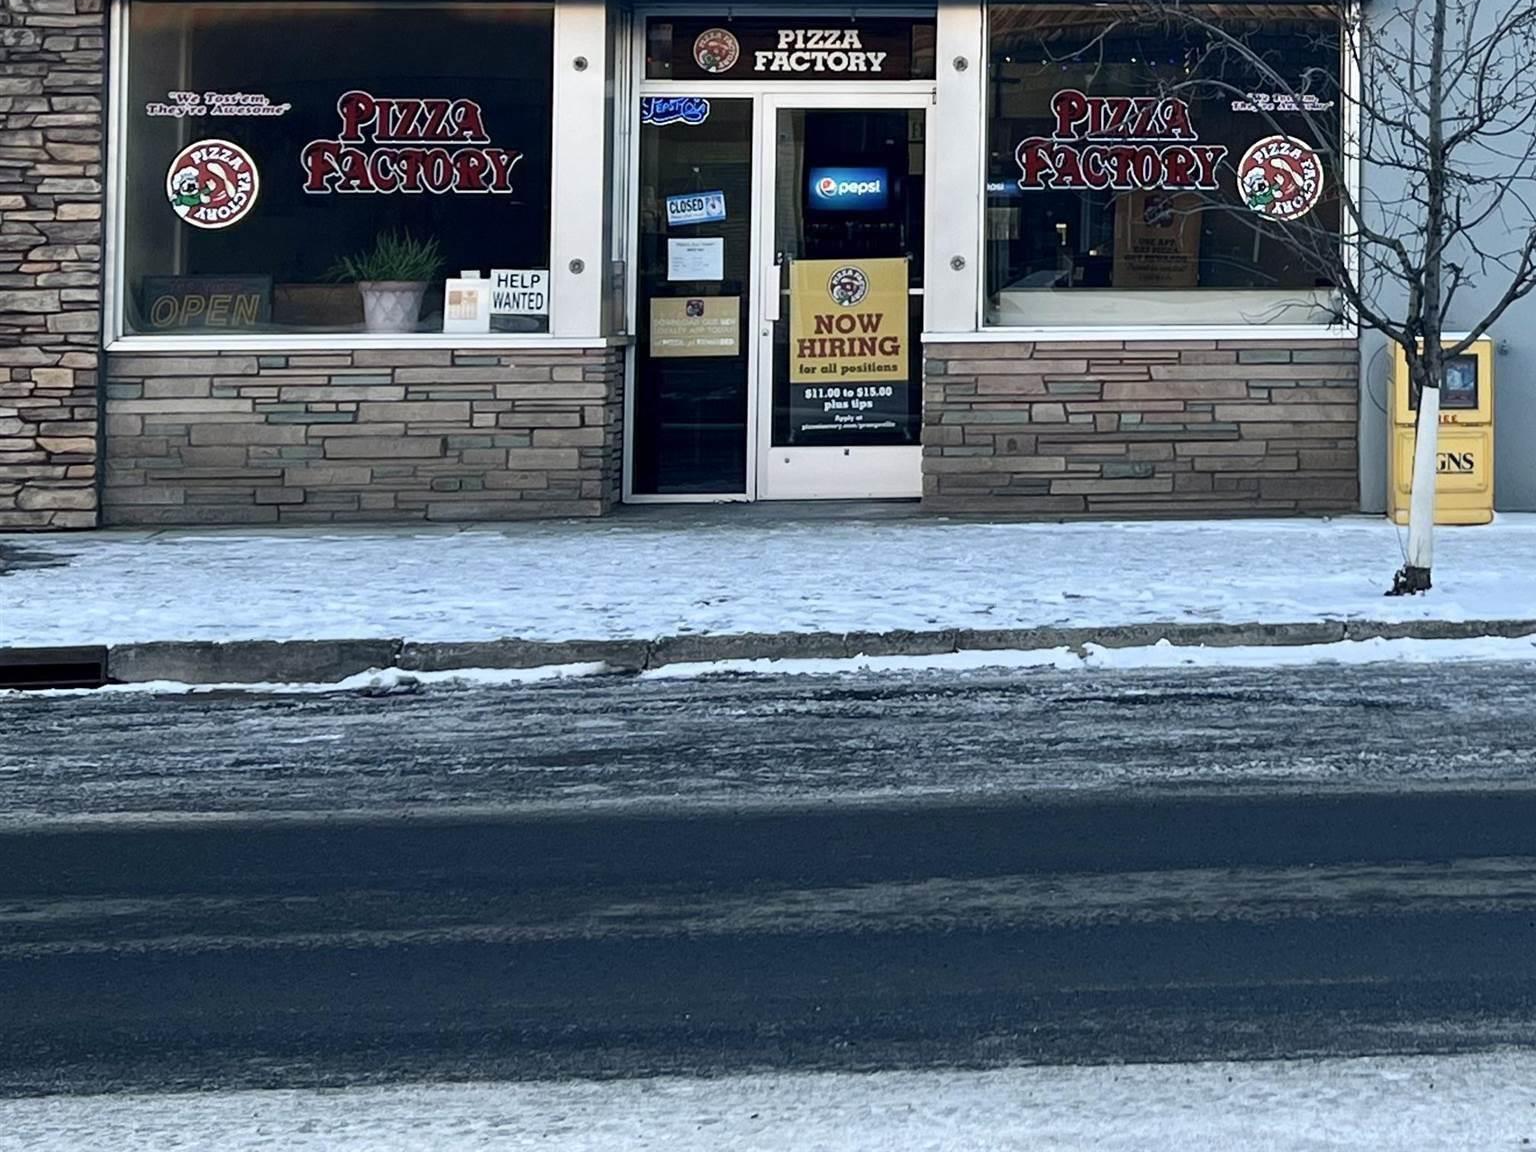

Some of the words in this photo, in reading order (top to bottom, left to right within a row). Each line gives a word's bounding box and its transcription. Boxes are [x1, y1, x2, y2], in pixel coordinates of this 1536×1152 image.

[777, 29, 862, 49] PIZZA
[754, 51, 887, 72] FACTORY
[337, 90, 491, 143] PIZZA
[1051, 89, 1198, 141] PIZZA
[190, 146, 243, 170] PIZZA
[1015, 136, 1228, 190] FACTORY
[1252, 143, 1302, 164] PIZZA
[301, 139, 524, 194] FACTORY
[194, 171, 251, 221] FACTORY
[838, 179, 881, 196] pepsi
[1272, 159, 1316, 214] FACTORY
[669, 198, 704, 214] CLOSED
[497, 273, 541, 289] HELP
[150, 295, 260, 327] OPEN
[493, 291, 544, 310] WANTED
[814, 313, 884, 335] NOW
[797, 336, 901, 358] HIRING
[799, 363, 817, 374] for
[820, 363, 837, 374] all
[840, 362, 898, 376] positions
[804, 388, 841, 399] $11.00
[842, 388, 854, 398] to
[856, 386, 893, 397] $15.00
[824, 399, 849, 411] plus
[851, 398, 873, 411] tips
